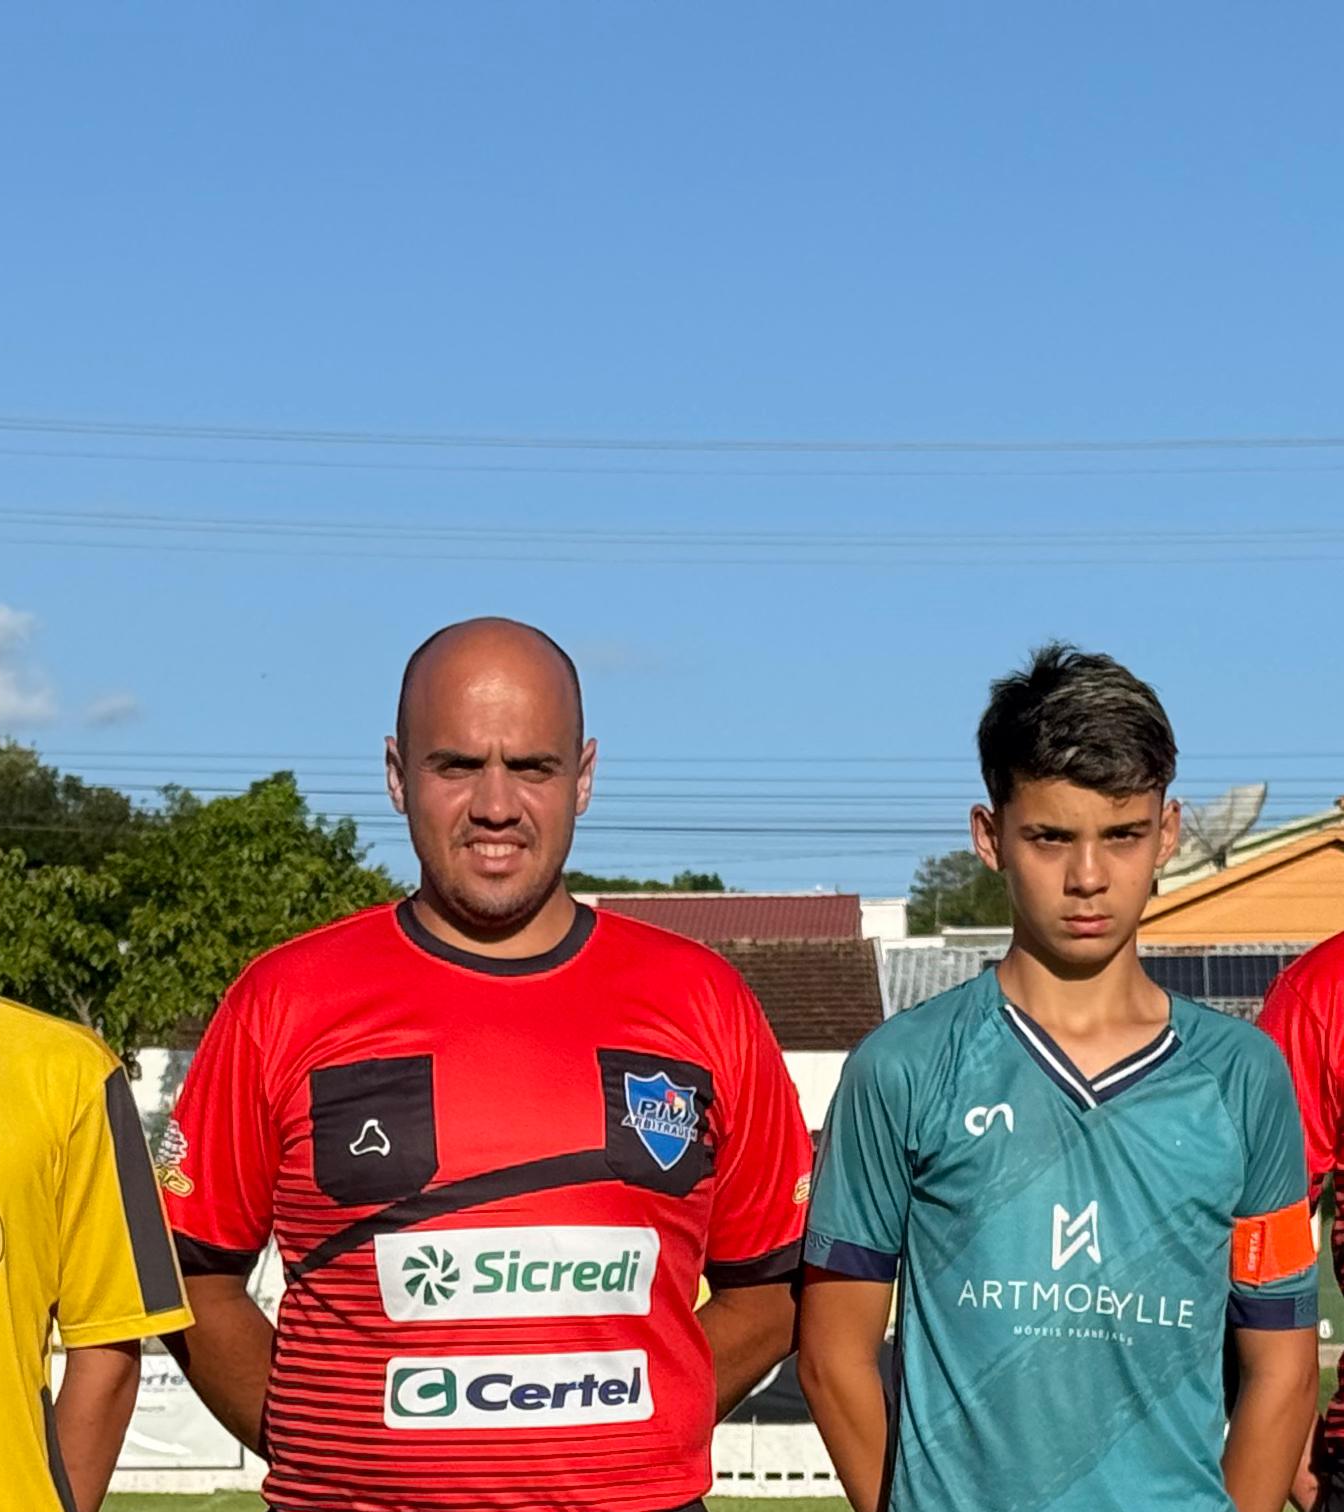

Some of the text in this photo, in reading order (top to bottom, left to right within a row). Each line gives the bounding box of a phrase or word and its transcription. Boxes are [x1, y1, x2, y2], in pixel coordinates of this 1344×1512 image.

[473, 1250, 641, 1294] Sicredi
[957, 1279, 1195, 1329] ARTMOBYLLE
[466, 1367, 641, 1411] Certel
